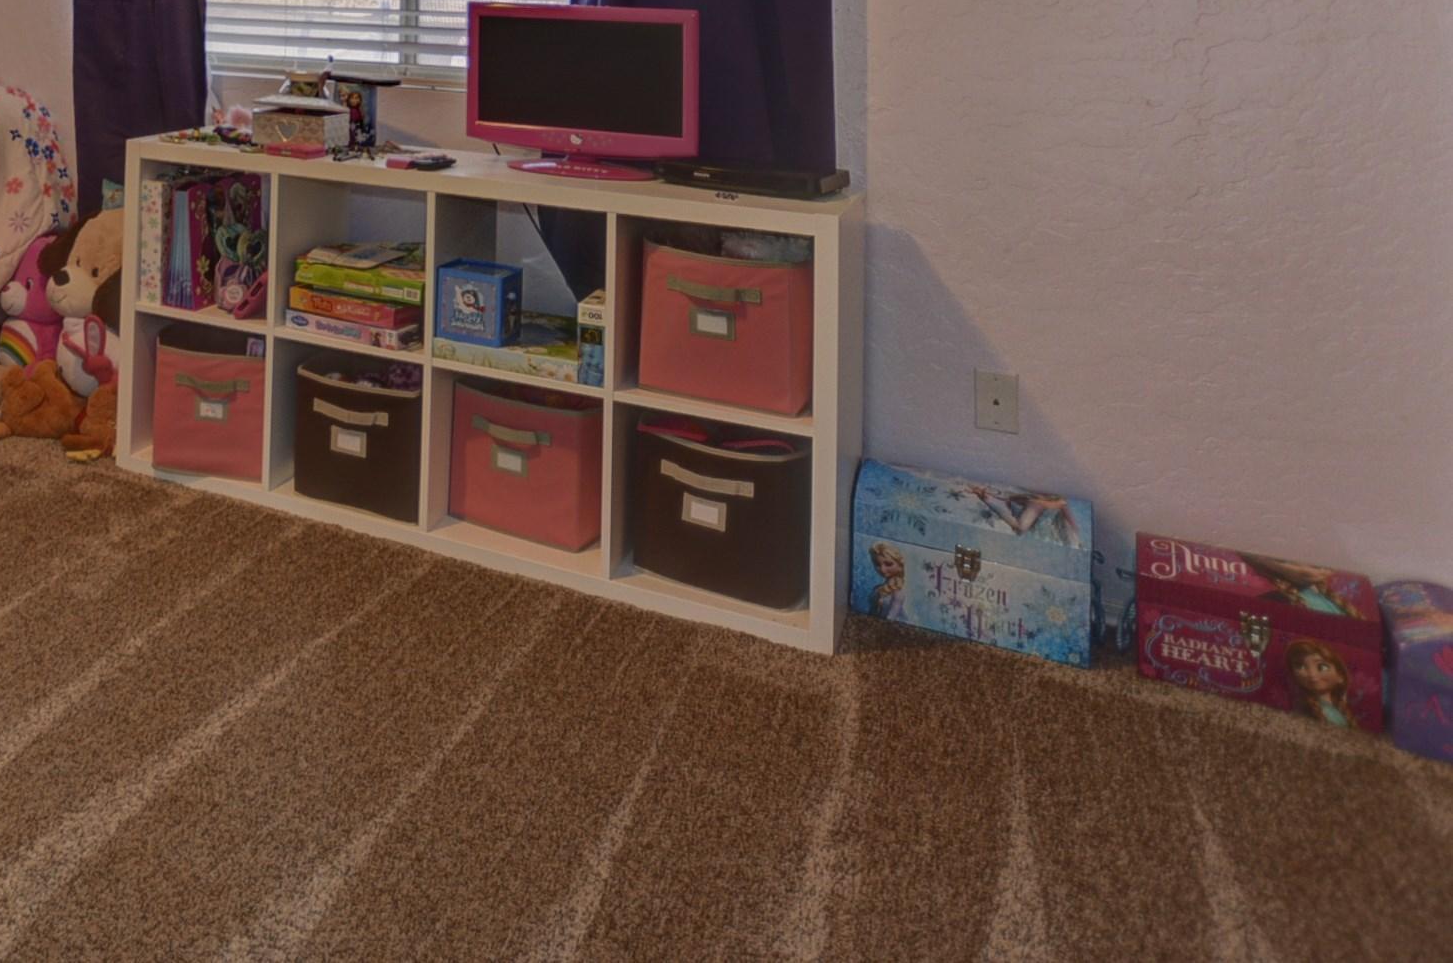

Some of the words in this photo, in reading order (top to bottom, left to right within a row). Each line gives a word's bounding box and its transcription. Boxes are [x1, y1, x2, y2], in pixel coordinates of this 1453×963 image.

[1150, 539, 1247, 579] Anna
[1160, 643, 1250, 676] HEART
[1163, 633, 1248, 661] RADIANT
